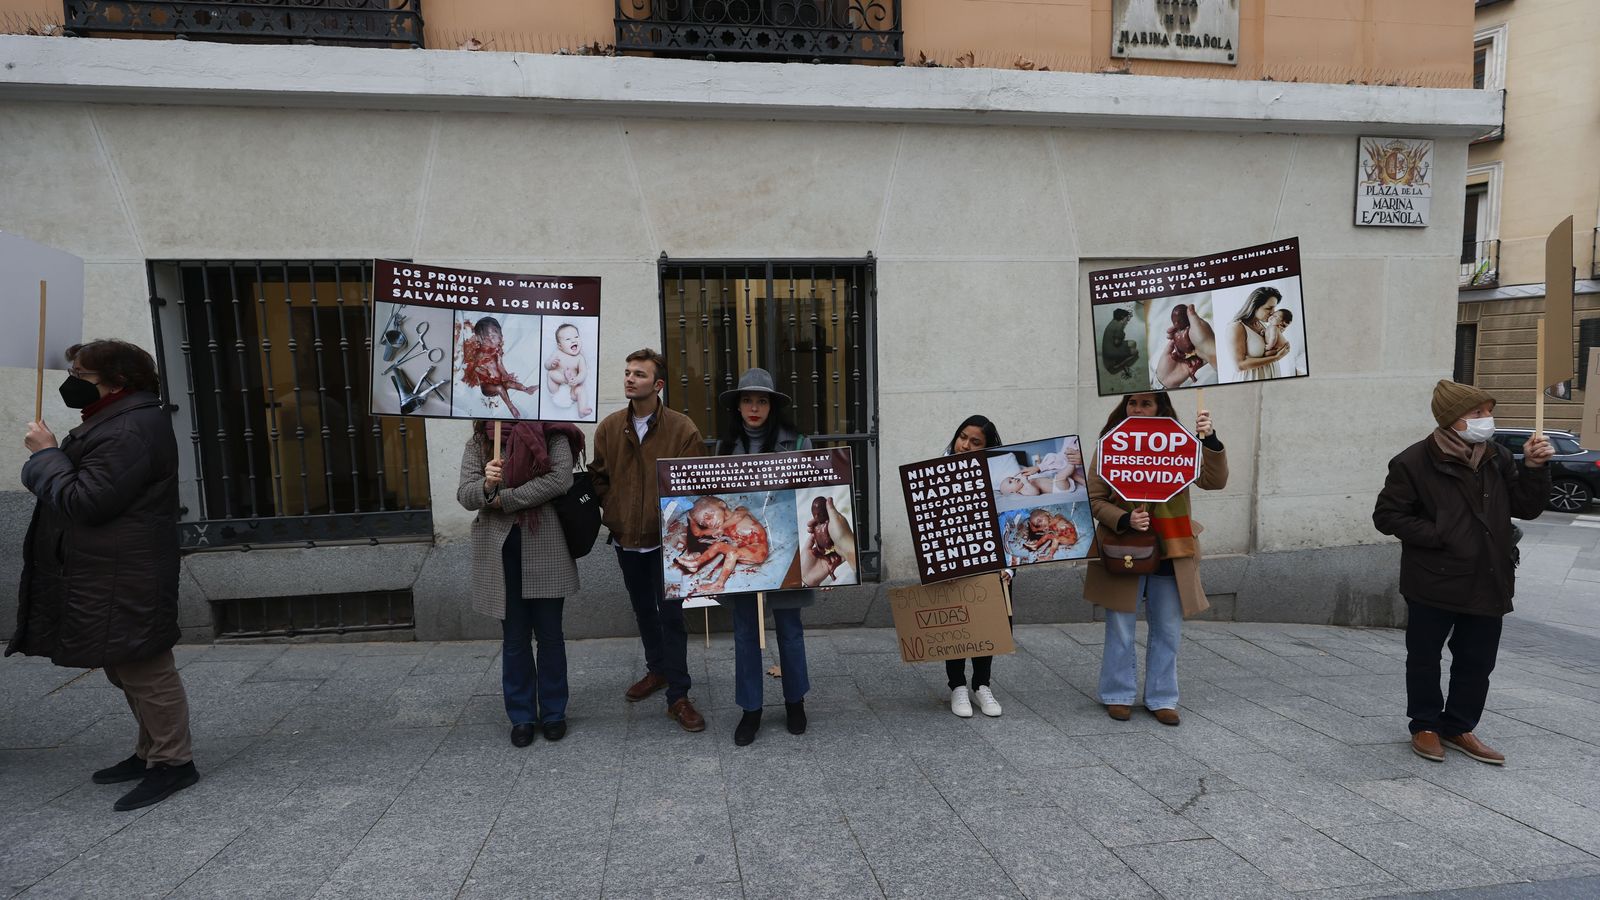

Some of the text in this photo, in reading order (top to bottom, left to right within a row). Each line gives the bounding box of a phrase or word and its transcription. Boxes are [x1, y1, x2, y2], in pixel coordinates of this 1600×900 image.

[1166, 14, 1190, 24] DE LA
[1120, 31, 1232, 49] MARINA ESPAÑOLA
[1367, 186, 1398, 195] PLAZA
[1372, 198, 1414, 210] MARINA
[1362, 210, 1424, 224] ESPAÑOLA
[1112, 263, 1189, 279] RESCATADORES
[1232, 245, 1294, 261] CRIMINALES.
[394, 267, 421, 278] LOS
[428, 272, 492, 286] PROVIDA
[520, 281, 574, 290] MATAMOS
[408, 280, 431, 289] LOS
[436, 283, 479, 293] NIÑOS.
[1095, 271, 1207, 291] SALVAN DOS VIDAS:
[1113, 290, 1132, 298] DEL
[1137, 283, 1165, 295] NIÑO
[1200, 277, 1215, 286] DE
[1220, 274, 1235, 283] SU
[1240, 265, 1289, 278] MADRE.
[392, 289, 585, 311] SALVAMOS A LOS NIÑOS.
[1112, 432, 1188, 452] STOP
[742, 457, 798, 466] PROPOSICIÓN
[908, 458, 980, 480] NINGUNA
[1104, 455, 1193, 467] PERSECUCIÓN
[910, 469, 982, 490] DE LAS 6010
[1110, 469, 1185, 484] PROVIDA
[912, 479, 985, 502] MADRES
[914, 492, 986, 512] RESCATADAS
[916, 501, 988, 521] DEL ABORTO
[918, 511, 990, 532] EN 2021 SE
[920, 521, 991, 541] ARREPIENTE
[922, 530, 993, 551] DE HABER
[923, 541, 995, 564] TENIDO
[927, 552, 997, 575] A SU BEBÉ
[896, 582, 987, 609] SALVAMOS
[918, 607, 968, 626] VIDAS
[901, 637, 924, 659] NO
[928, 640, 994, 657] CRIMINALES
